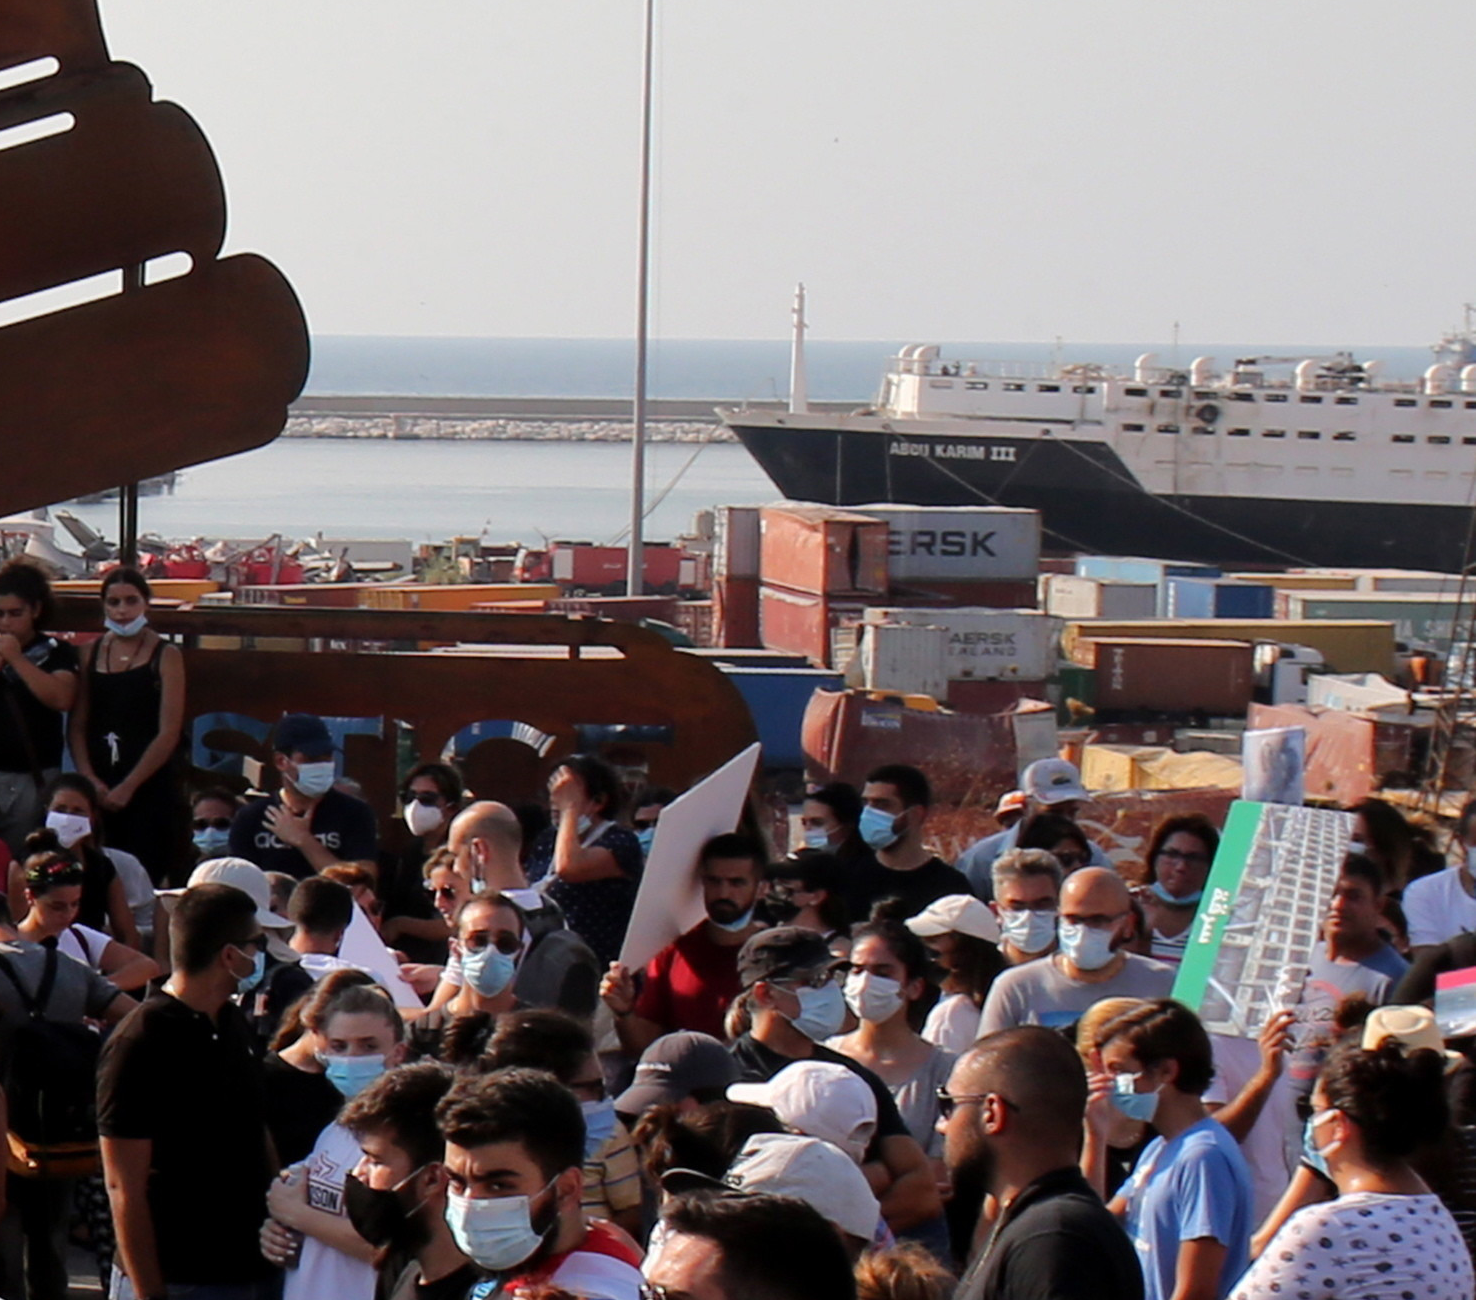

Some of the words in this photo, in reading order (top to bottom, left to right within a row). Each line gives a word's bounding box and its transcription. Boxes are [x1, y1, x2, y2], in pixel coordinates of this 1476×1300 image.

[934, 444, 985, 459] KARIM
[990, 446, 1016, 461] III
[888, 530, 996, 557] ERSK
[949, 632, 1015, 645] AERSK
